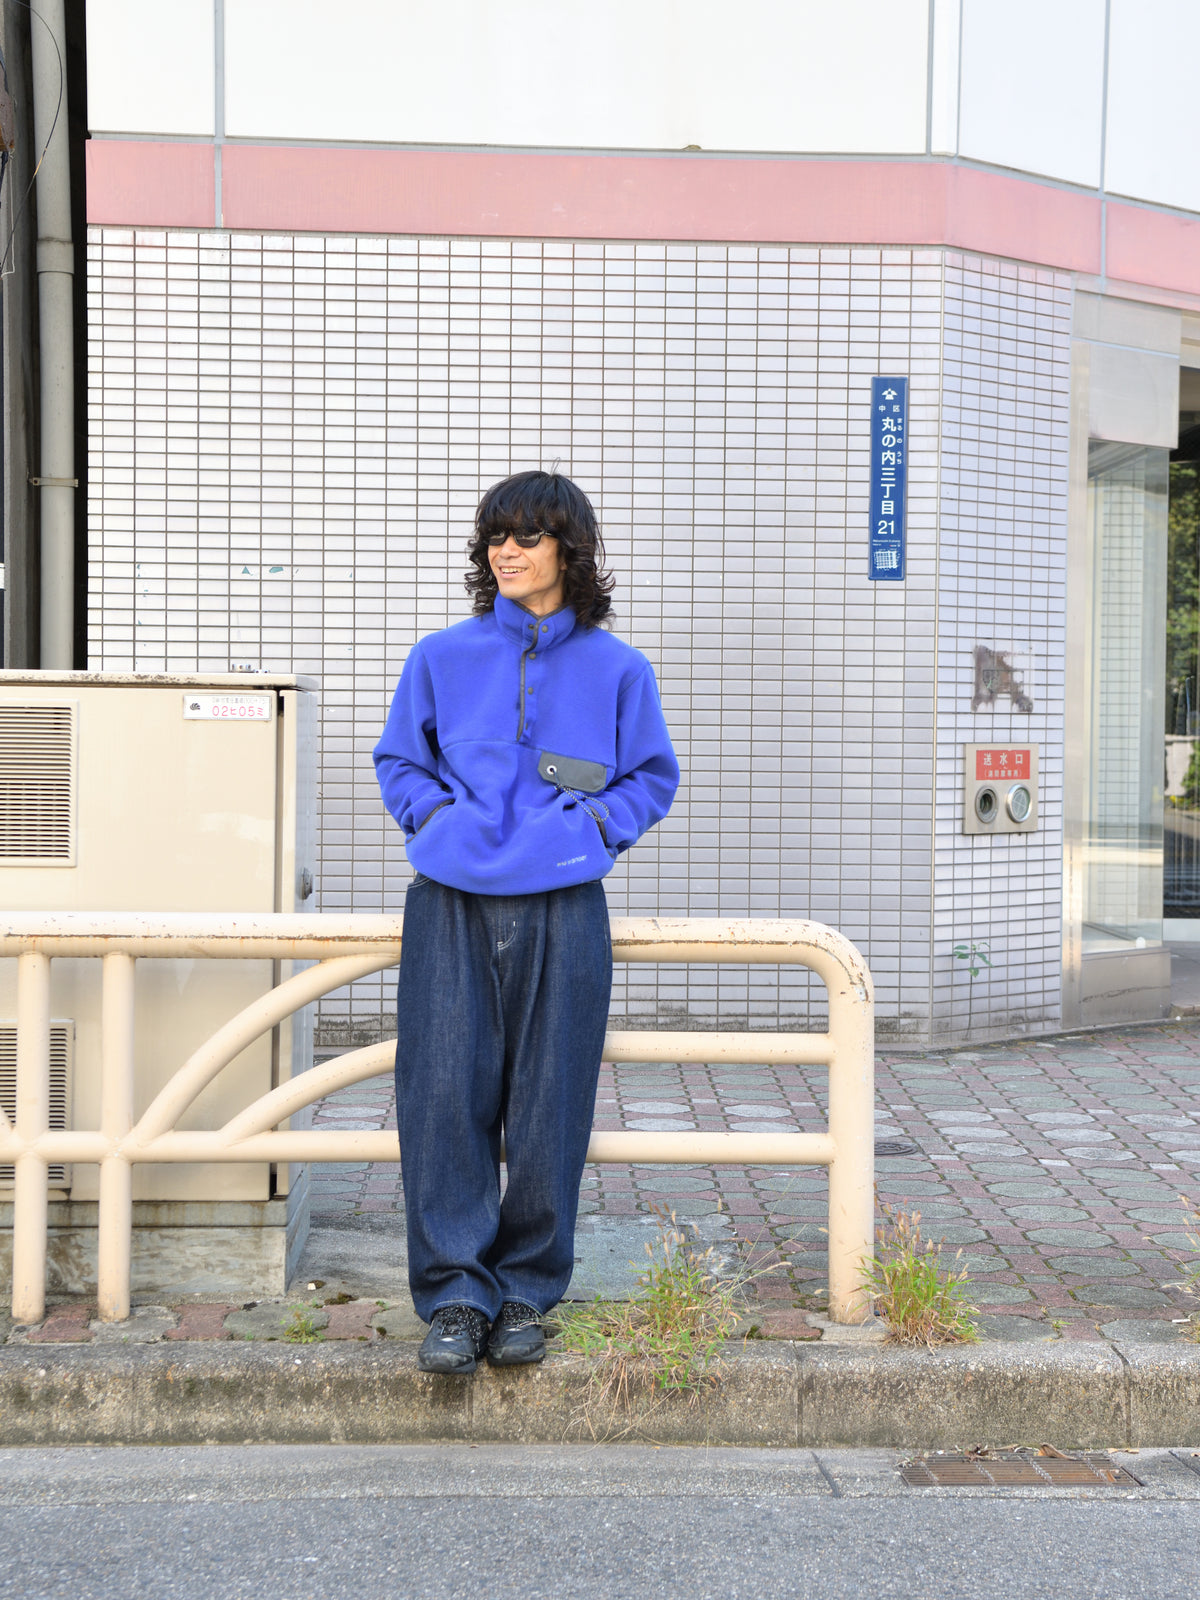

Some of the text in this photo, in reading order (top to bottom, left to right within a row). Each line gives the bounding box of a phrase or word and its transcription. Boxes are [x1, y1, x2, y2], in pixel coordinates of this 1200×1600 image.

[880, 416, 897, 515] 丸の内三丁目
[877, 520, 895, 535] 21
[212, 705, 264, 717] 02ヒ05ミ
[983, 752, 1023, 766] 送水口
